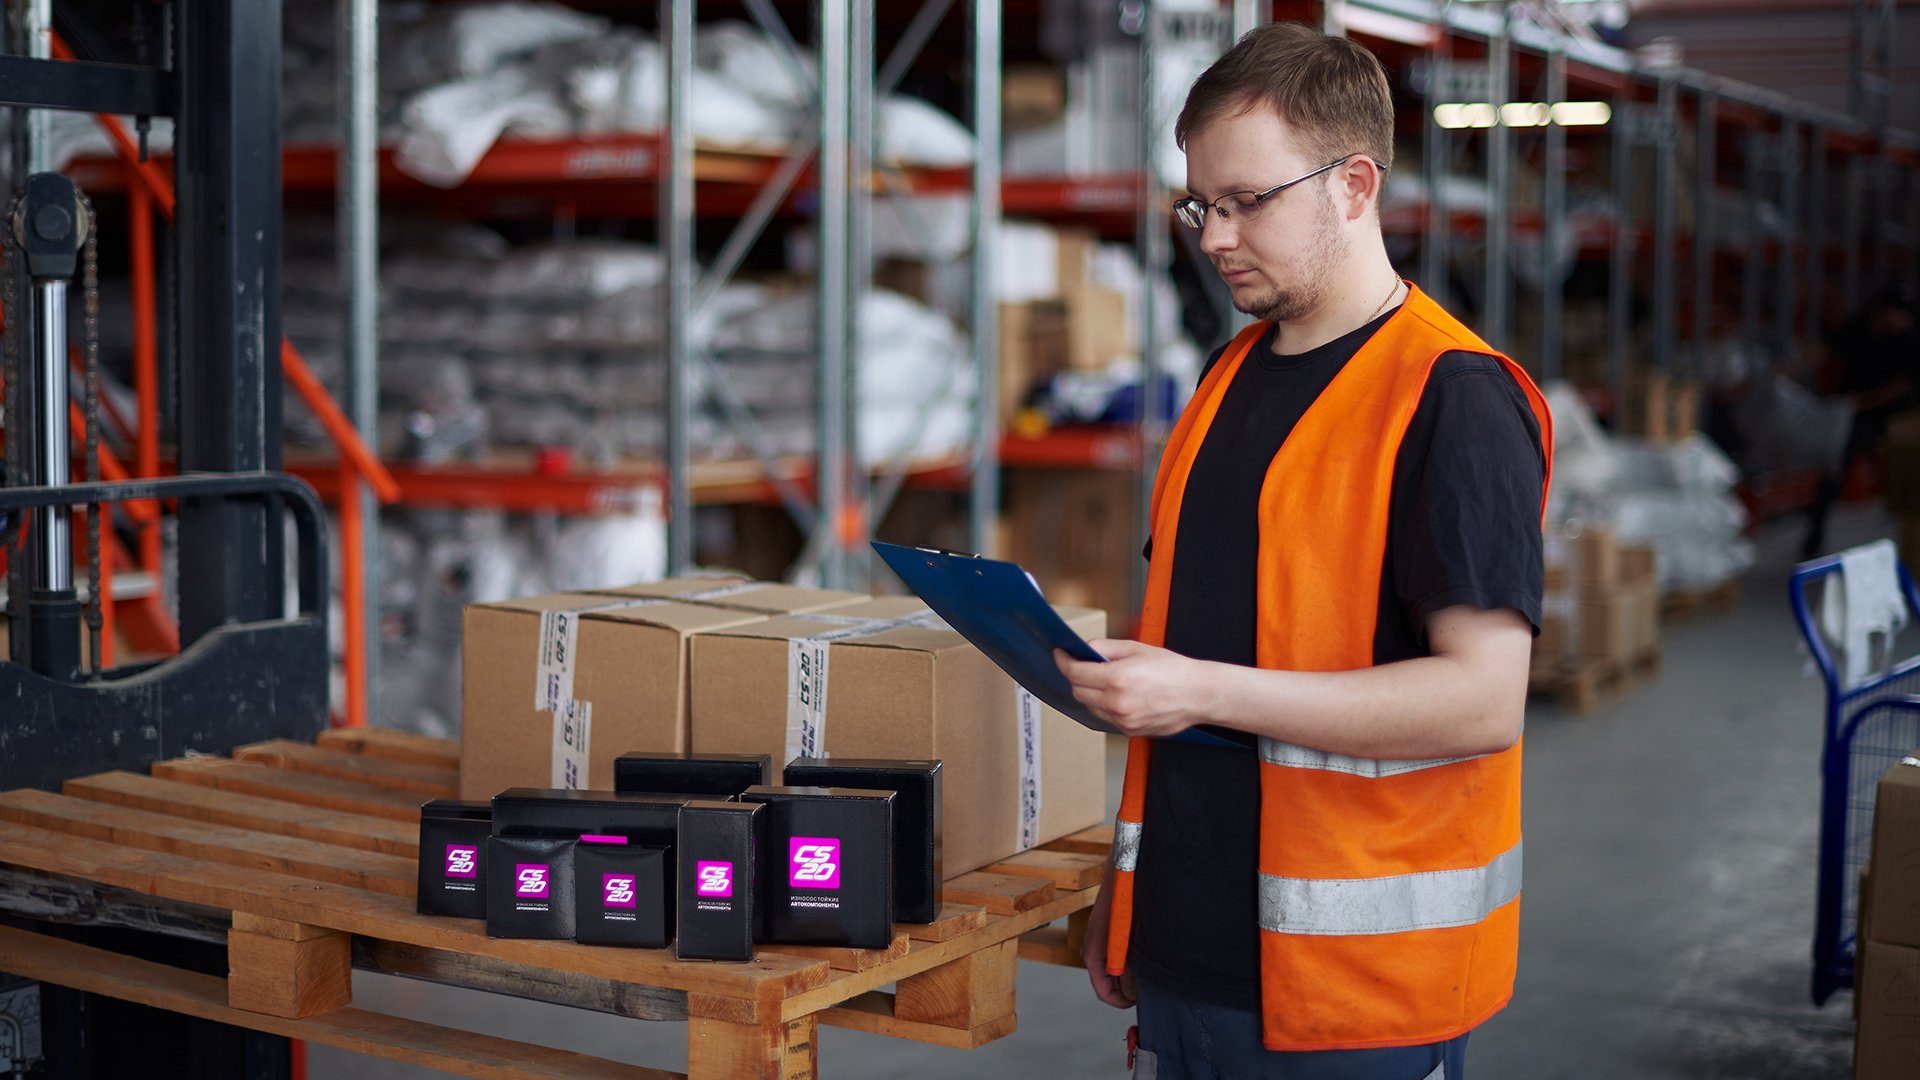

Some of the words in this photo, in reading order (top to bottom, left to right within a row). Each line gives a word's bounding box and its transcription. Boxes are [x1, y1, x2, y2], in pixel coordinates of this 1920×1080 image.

[556, 614, 568, 664] CS-20
[800, 652, 810, 705] CS-20
[448, 849, 475, 862] CS
[794, 845, 836, 863] CS
[448, 861, 475, 873] 20
[700, 866, 729, 879] CS
[794, 862, 837, 881] 20
[518, 868, 546, 881] CS
[518, 880, 547, 893] 20
[605, 879, 633, 891] CS
[700, 878, 730, 891] 20
[606, 890, 634, 902] 20
